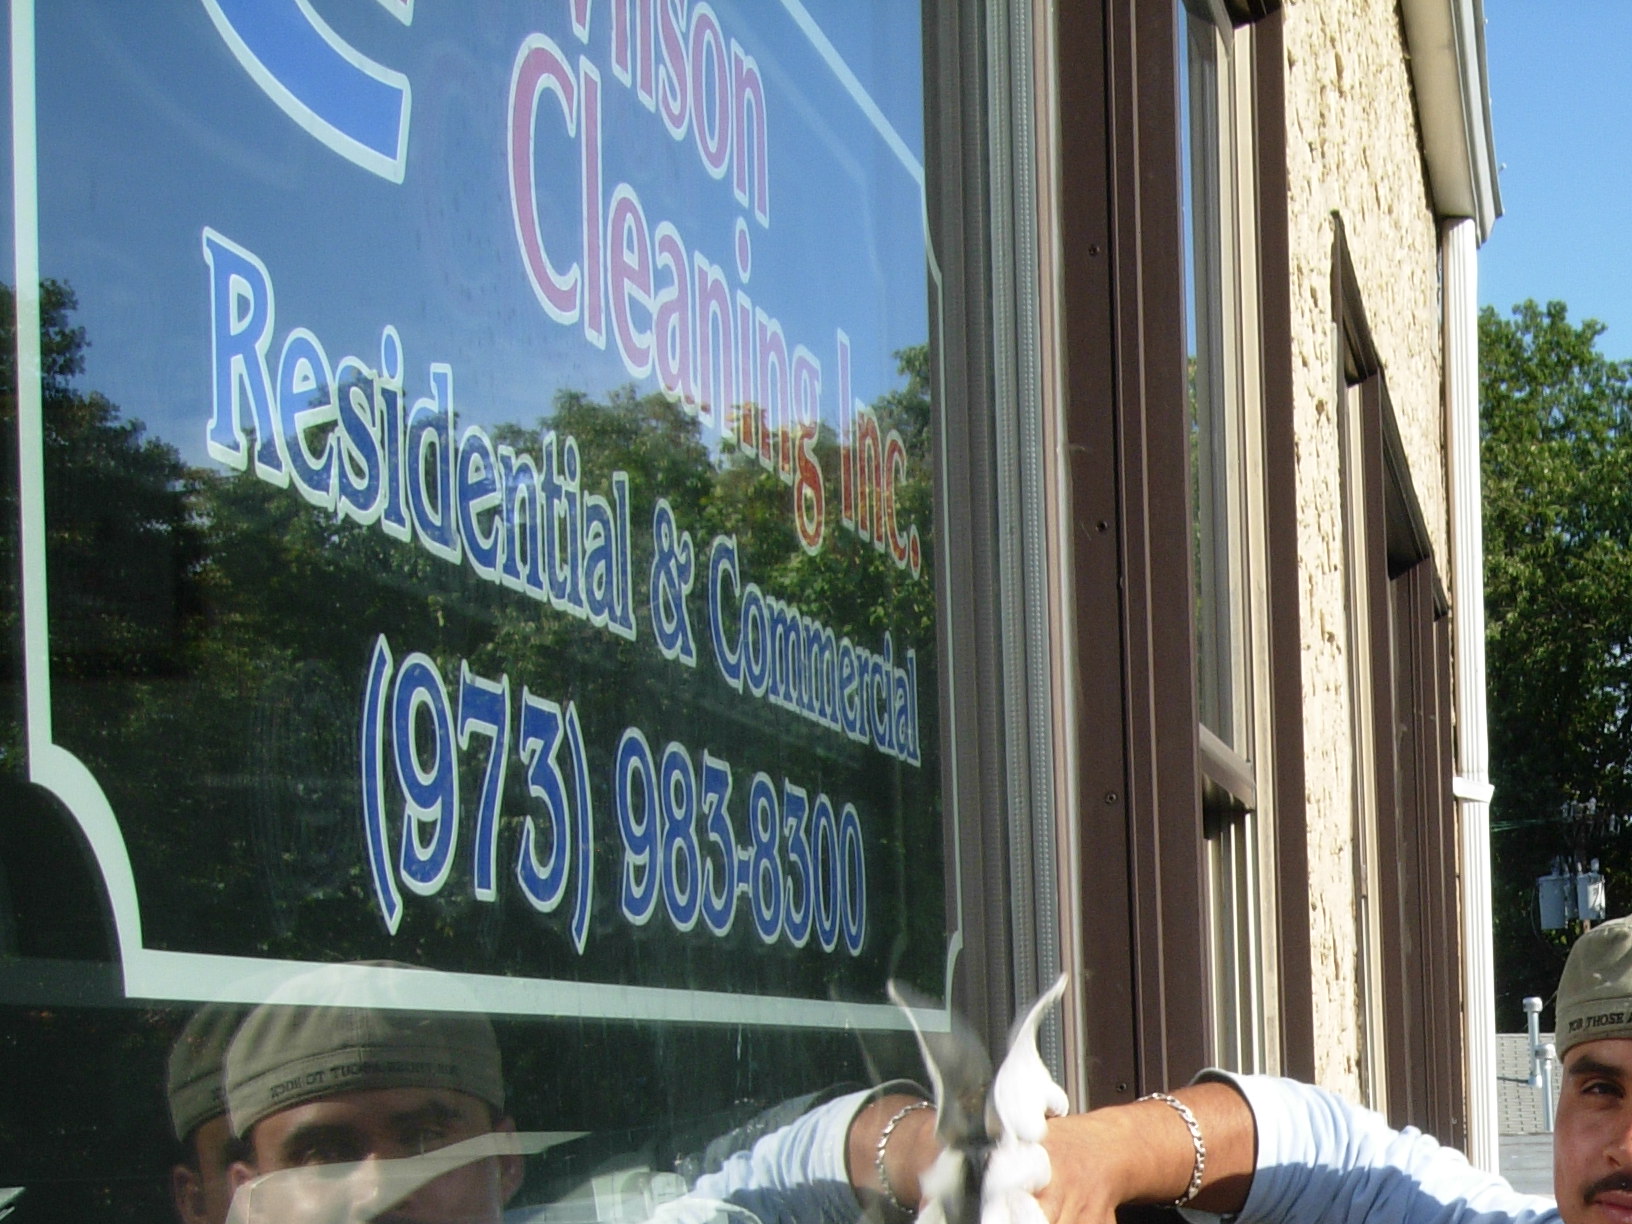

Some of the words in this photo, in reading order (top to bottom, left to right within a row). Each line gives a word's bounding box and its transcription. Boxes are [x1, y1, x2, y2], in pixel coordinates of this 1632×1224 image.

[203, 226, 637, 641] Residential
[650, 498, 697, 667] &
[708, 533, 922, 768] Commercial
[507, 32, 825, 556] Cleaning
[837, 327, 921, 582] Inc.
[359, 633, 593, 955] (973)
[616, 726, 867, 957] 983-8300
[1585, 1011, 1624, 1029] THOSE
